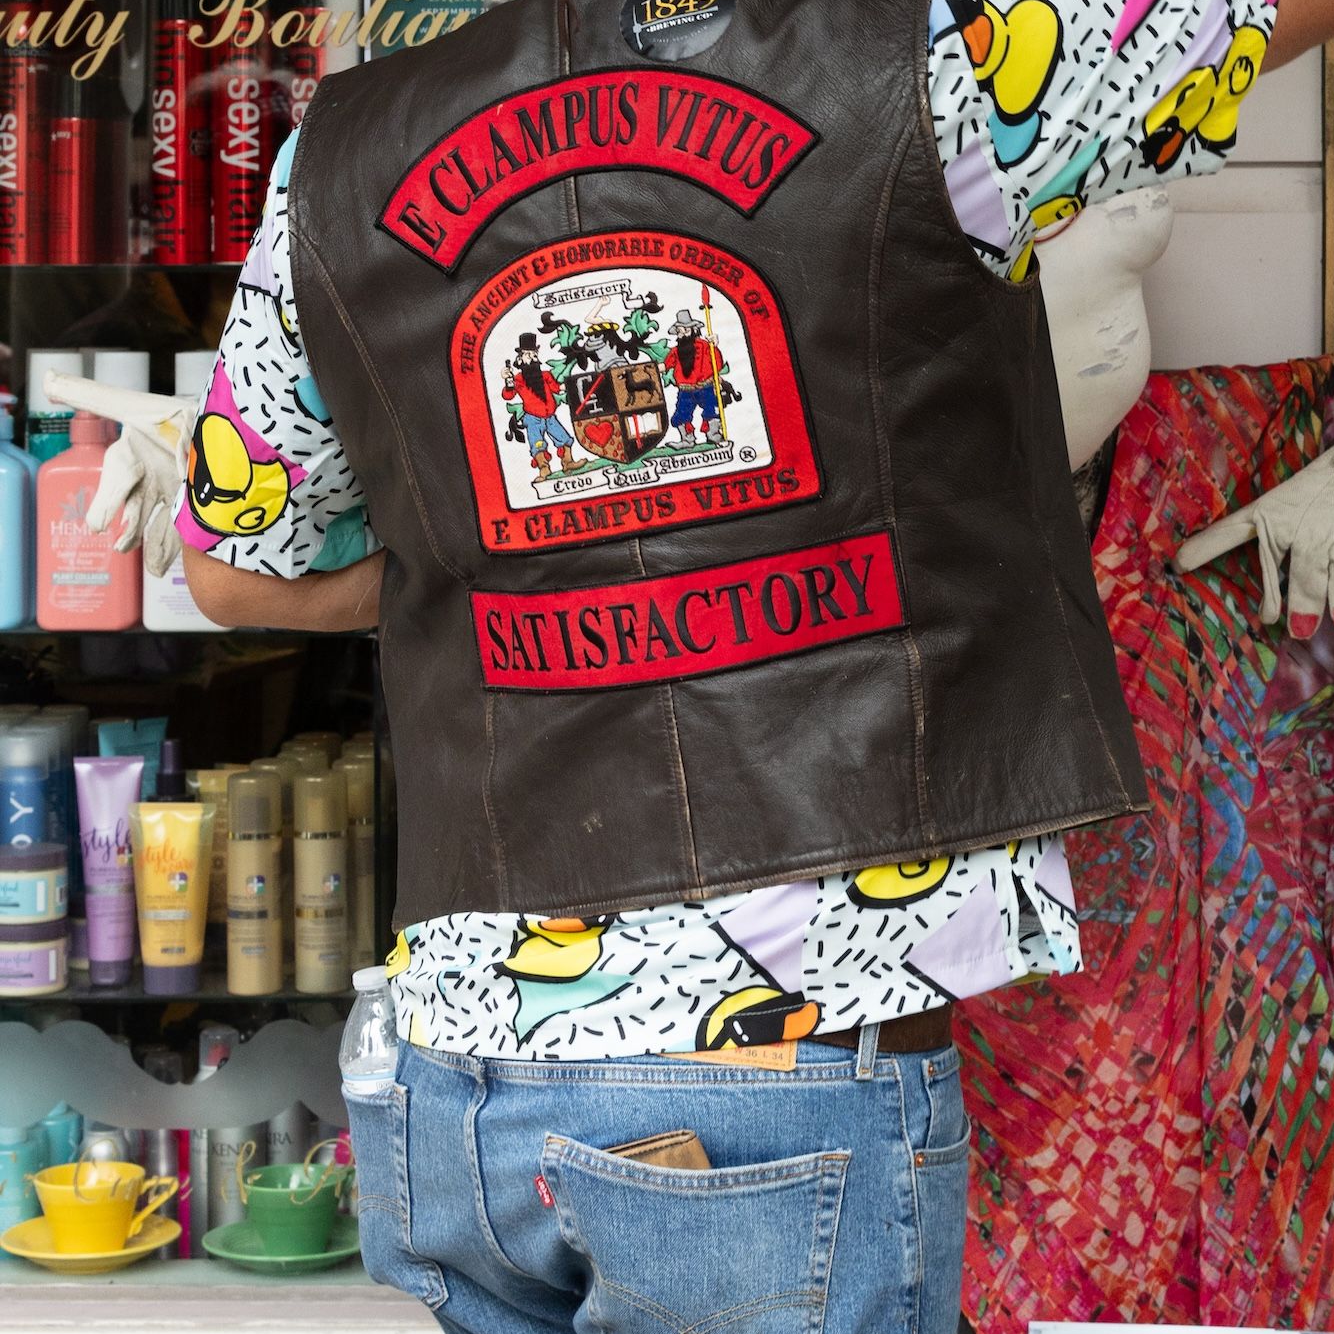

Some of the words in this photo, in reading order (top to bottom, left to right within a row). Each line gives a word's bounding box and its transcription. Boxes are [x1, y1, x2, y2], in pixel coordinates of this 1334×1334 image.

[649, 16, 696, 33] BREWING
[397, 202, 448, 255] E
[428, 81, 640, 216] CLAMPUS
[657, 85, 792, 189] VITUS
[460, 332, 477, 376] THE
[470, 266, 530, 333] ANCIENT
[552, 238, 665, 269] HONORABLE
[669, 240, 745, 288] ORDER
[743, 289, 771, 320] OF
[544, 282, 628, 307] Satisfactory
[491, 519, 511, 545] E
[524, 491, 677, 542] CLAMPUS
[691, 467, 801, 511] VITUS
[553, 475, 593, 494] Credo
[613, 470, 651, 489] Quia
[659, 450, 733, 474] Absurdum
[486, 554, 874, 672] SATISFACTORY
